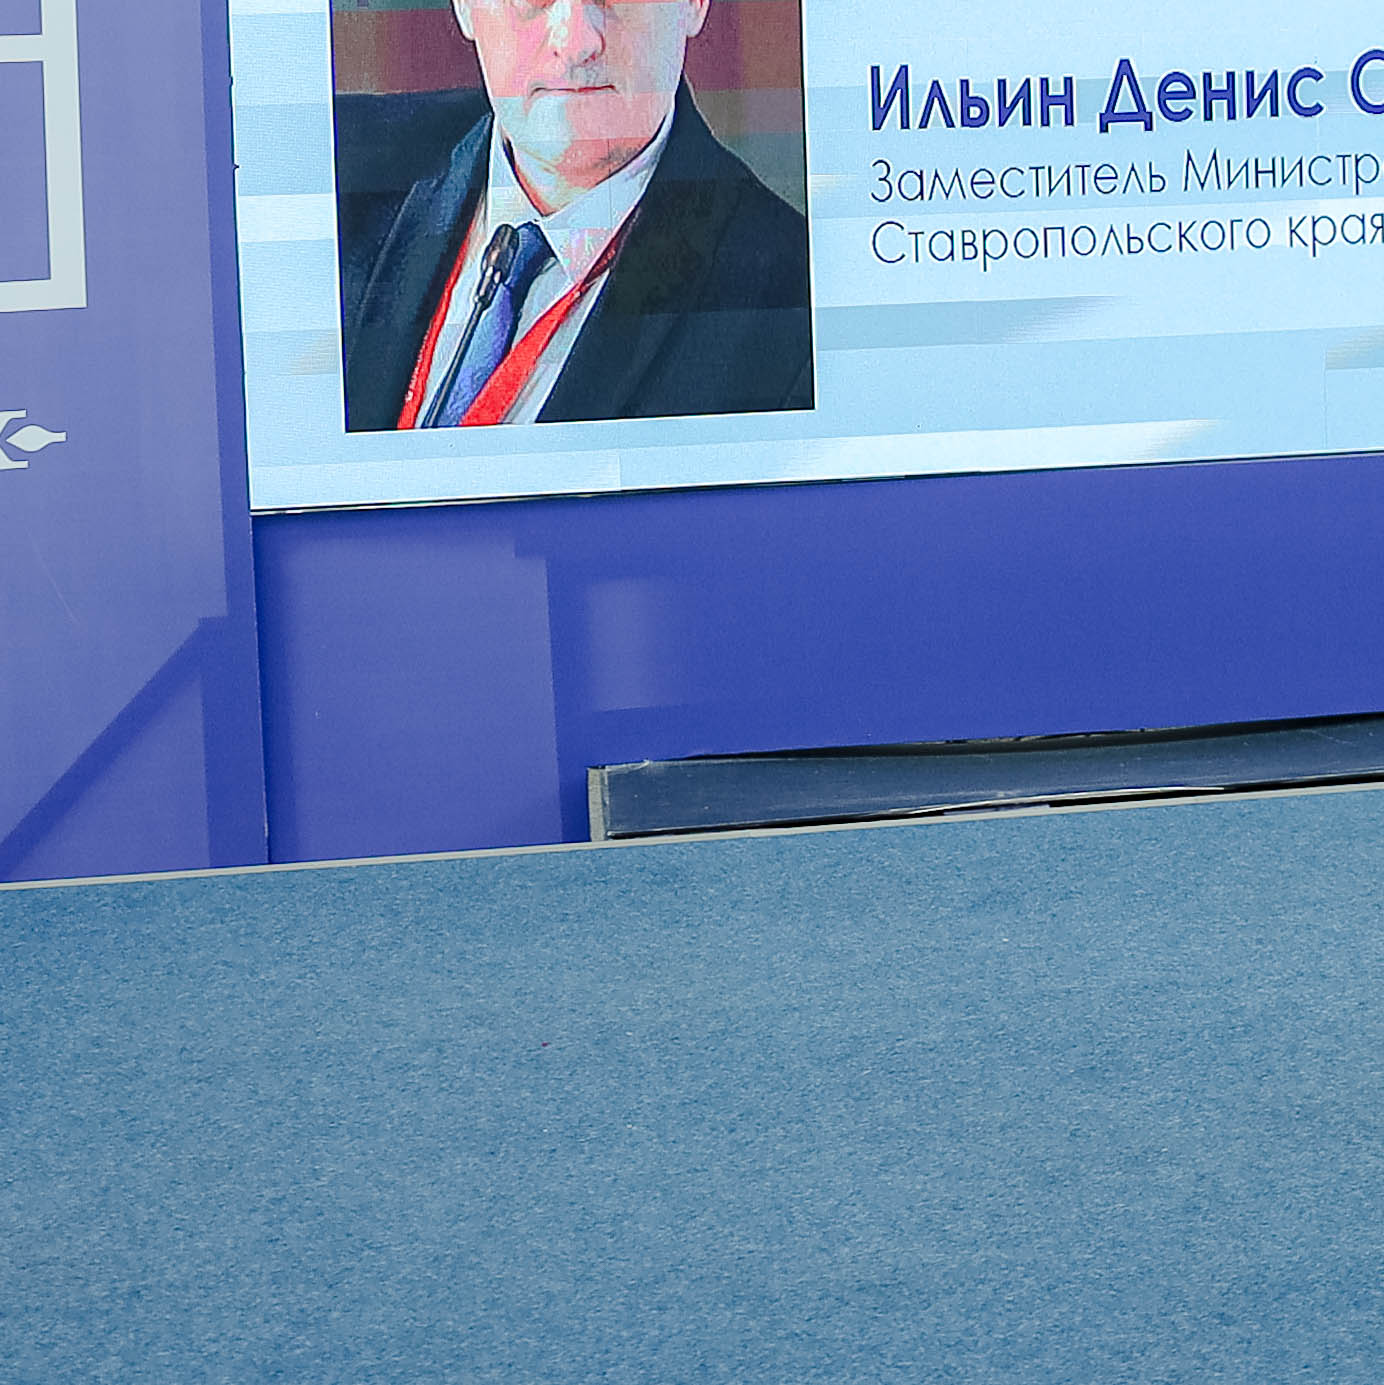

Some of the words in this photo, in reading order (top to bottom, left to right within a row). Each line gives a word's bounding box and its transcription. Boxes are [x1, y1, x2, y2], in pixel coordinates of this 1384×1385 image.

[869, 64, 1076, 132] Ильин
[1098, 58, 1325, 134] Денис
[870, 159, 1166, 203] Заместитель
[871, 218, 1271, 273] Ставропольского
